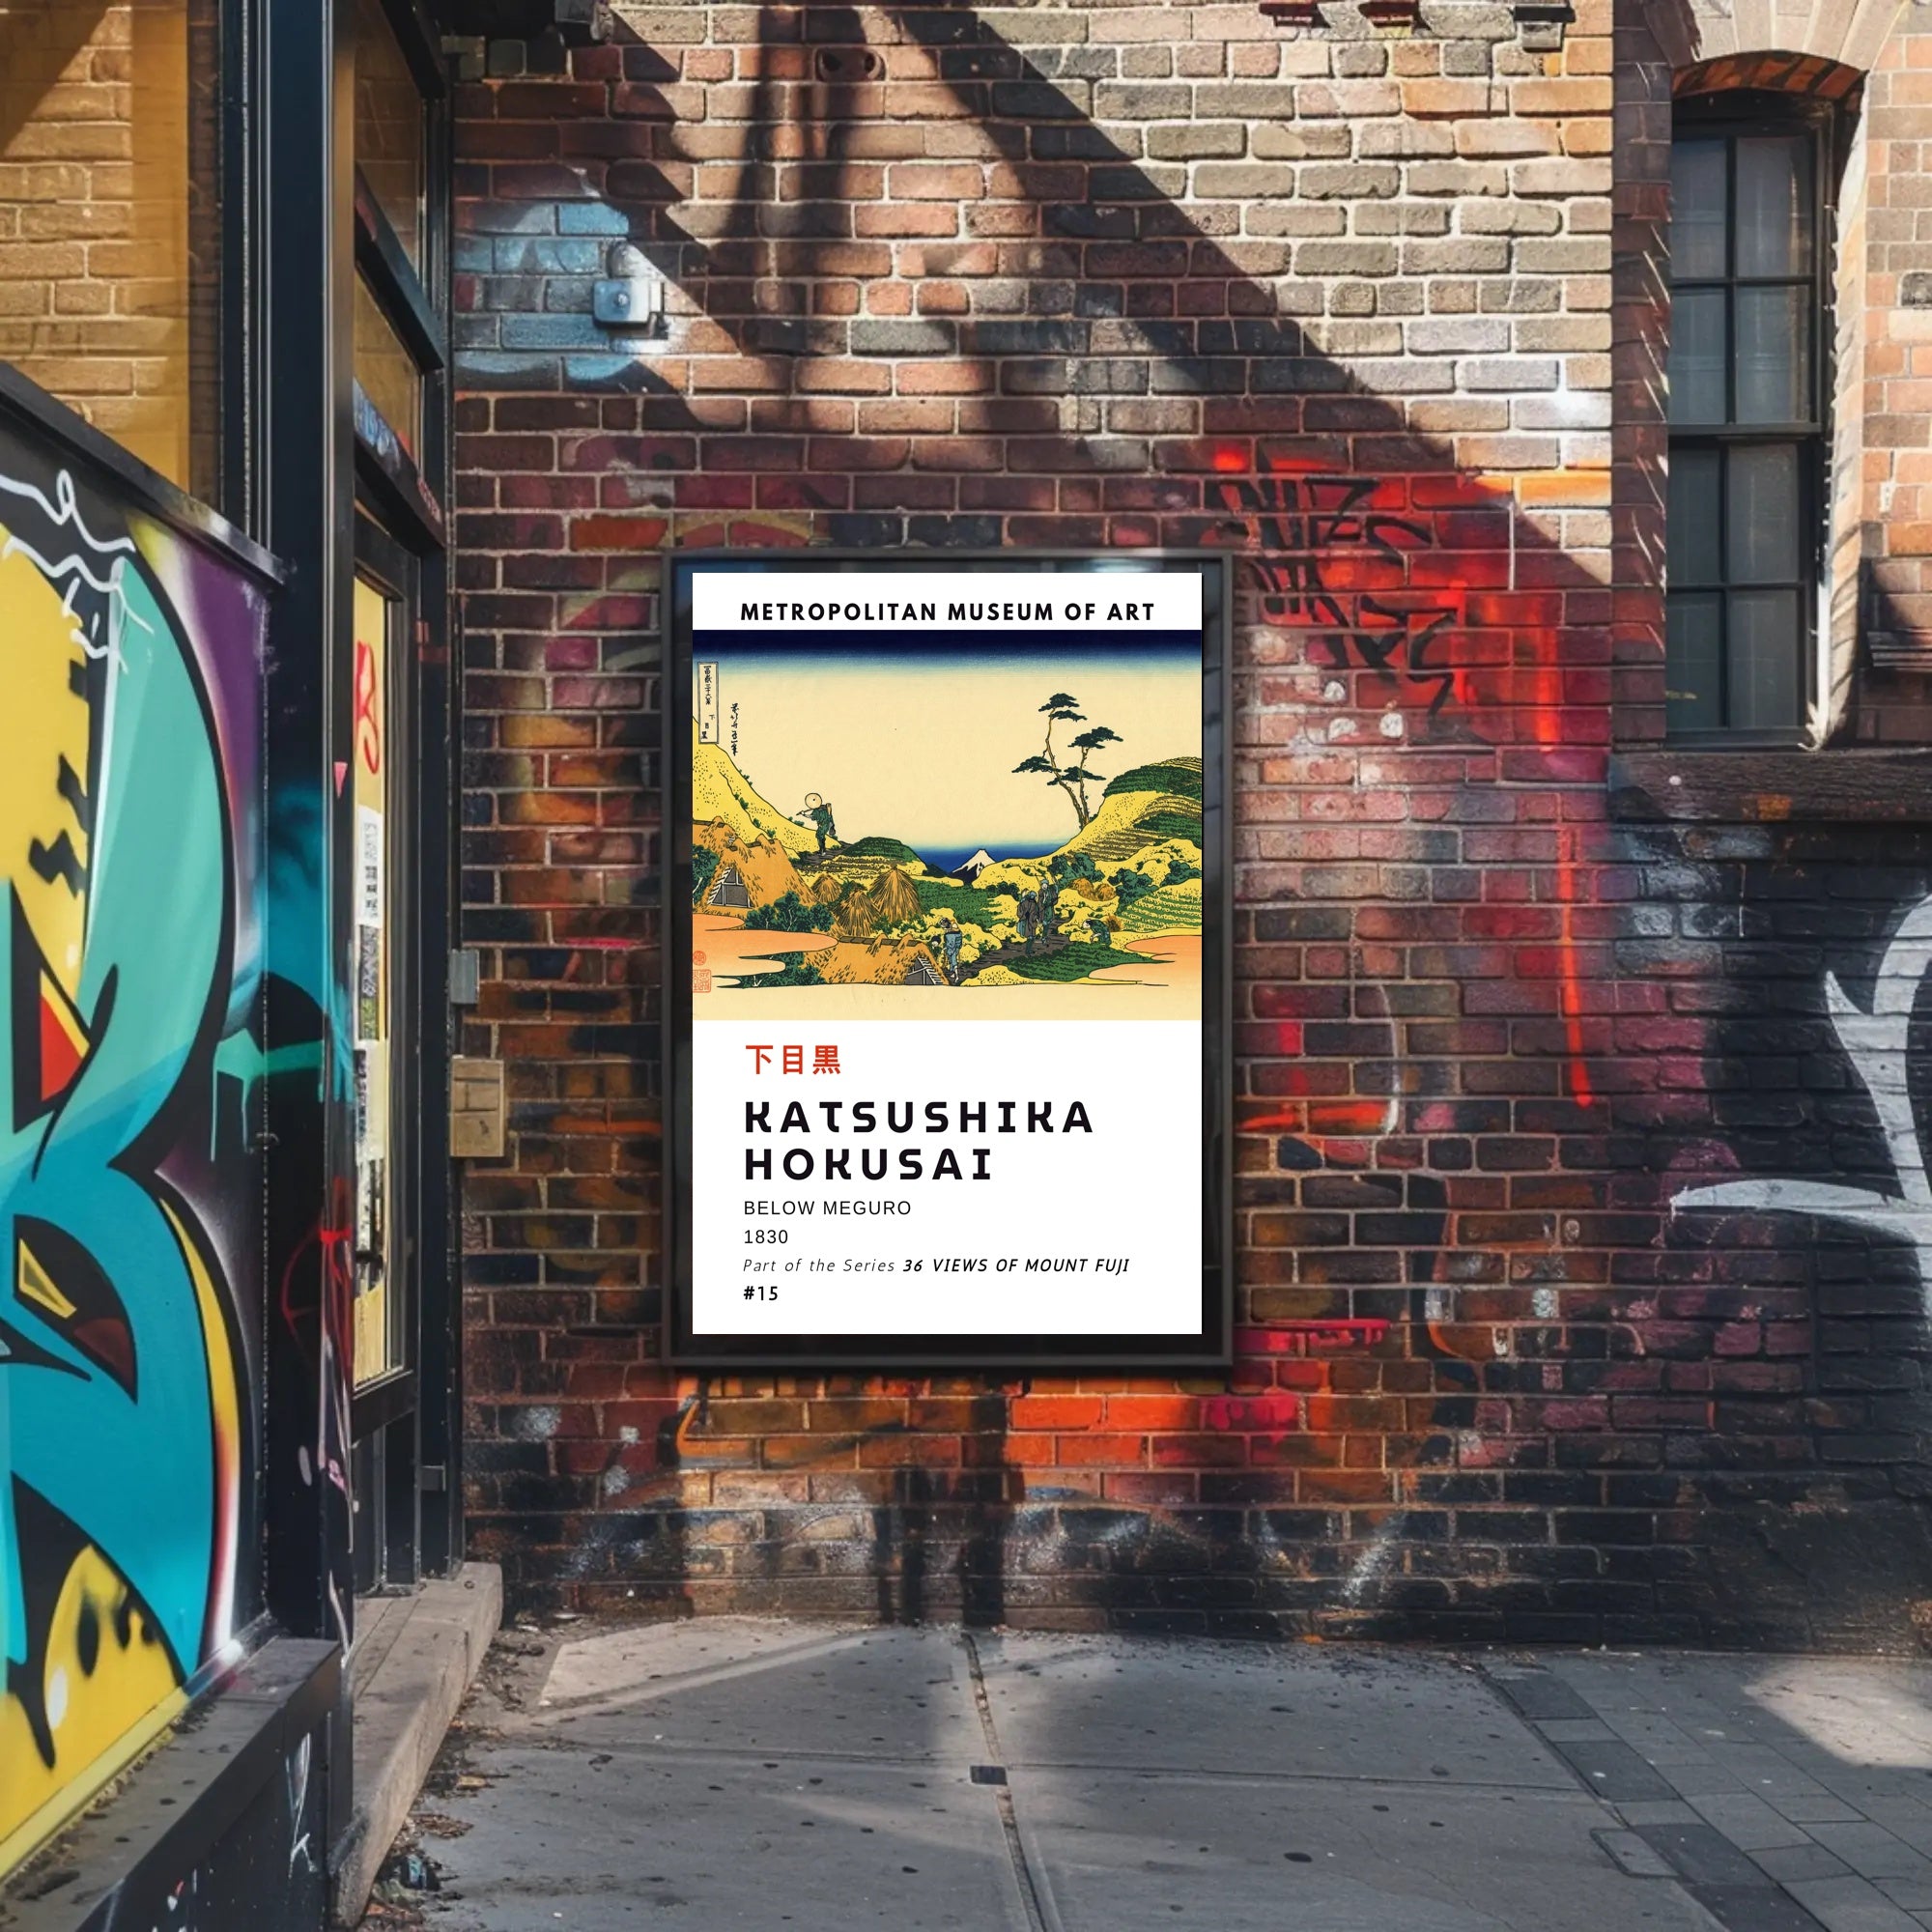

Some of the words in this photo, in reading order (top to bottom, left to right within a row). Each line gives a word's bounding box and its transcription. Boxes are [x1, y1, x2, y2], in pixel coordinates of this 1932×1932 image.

[740, 602, 936, 621] METROPOLITAN
[948, 602, 1053, 621] MUSEUM
[1065, 602, 1095, 621] OF
[1106, 603, 1154, 621] ART
[745, 1044, 841, 1075] 下目黒
[745, 1100, 1094, 1134] KATSUSHIKA
[745, 1148, 991, 1180] HOKUSAI
[744, 1200, 815, 1215] BELOW
[823, 1200, 911, 1215] MEGURO
[744, 1229, 788, 1244] 1830
[743, 1259, 777, 1272] Part
[784, 1258, 803, 1272] of
[810, 1258, 836, 1272] the
[842, 1258, 895, 1272] Series
[902, 1259, 923, 1272] 36
[932, 1258, 988, 1272] VIEWS
[995, 1258, 1019, 1272] OF
[1024, 1258, 1089, 1272] MOUNT
[1094, 1258, 1130, 1275] FUJI
[743, 1285, 779, 1301] #15
